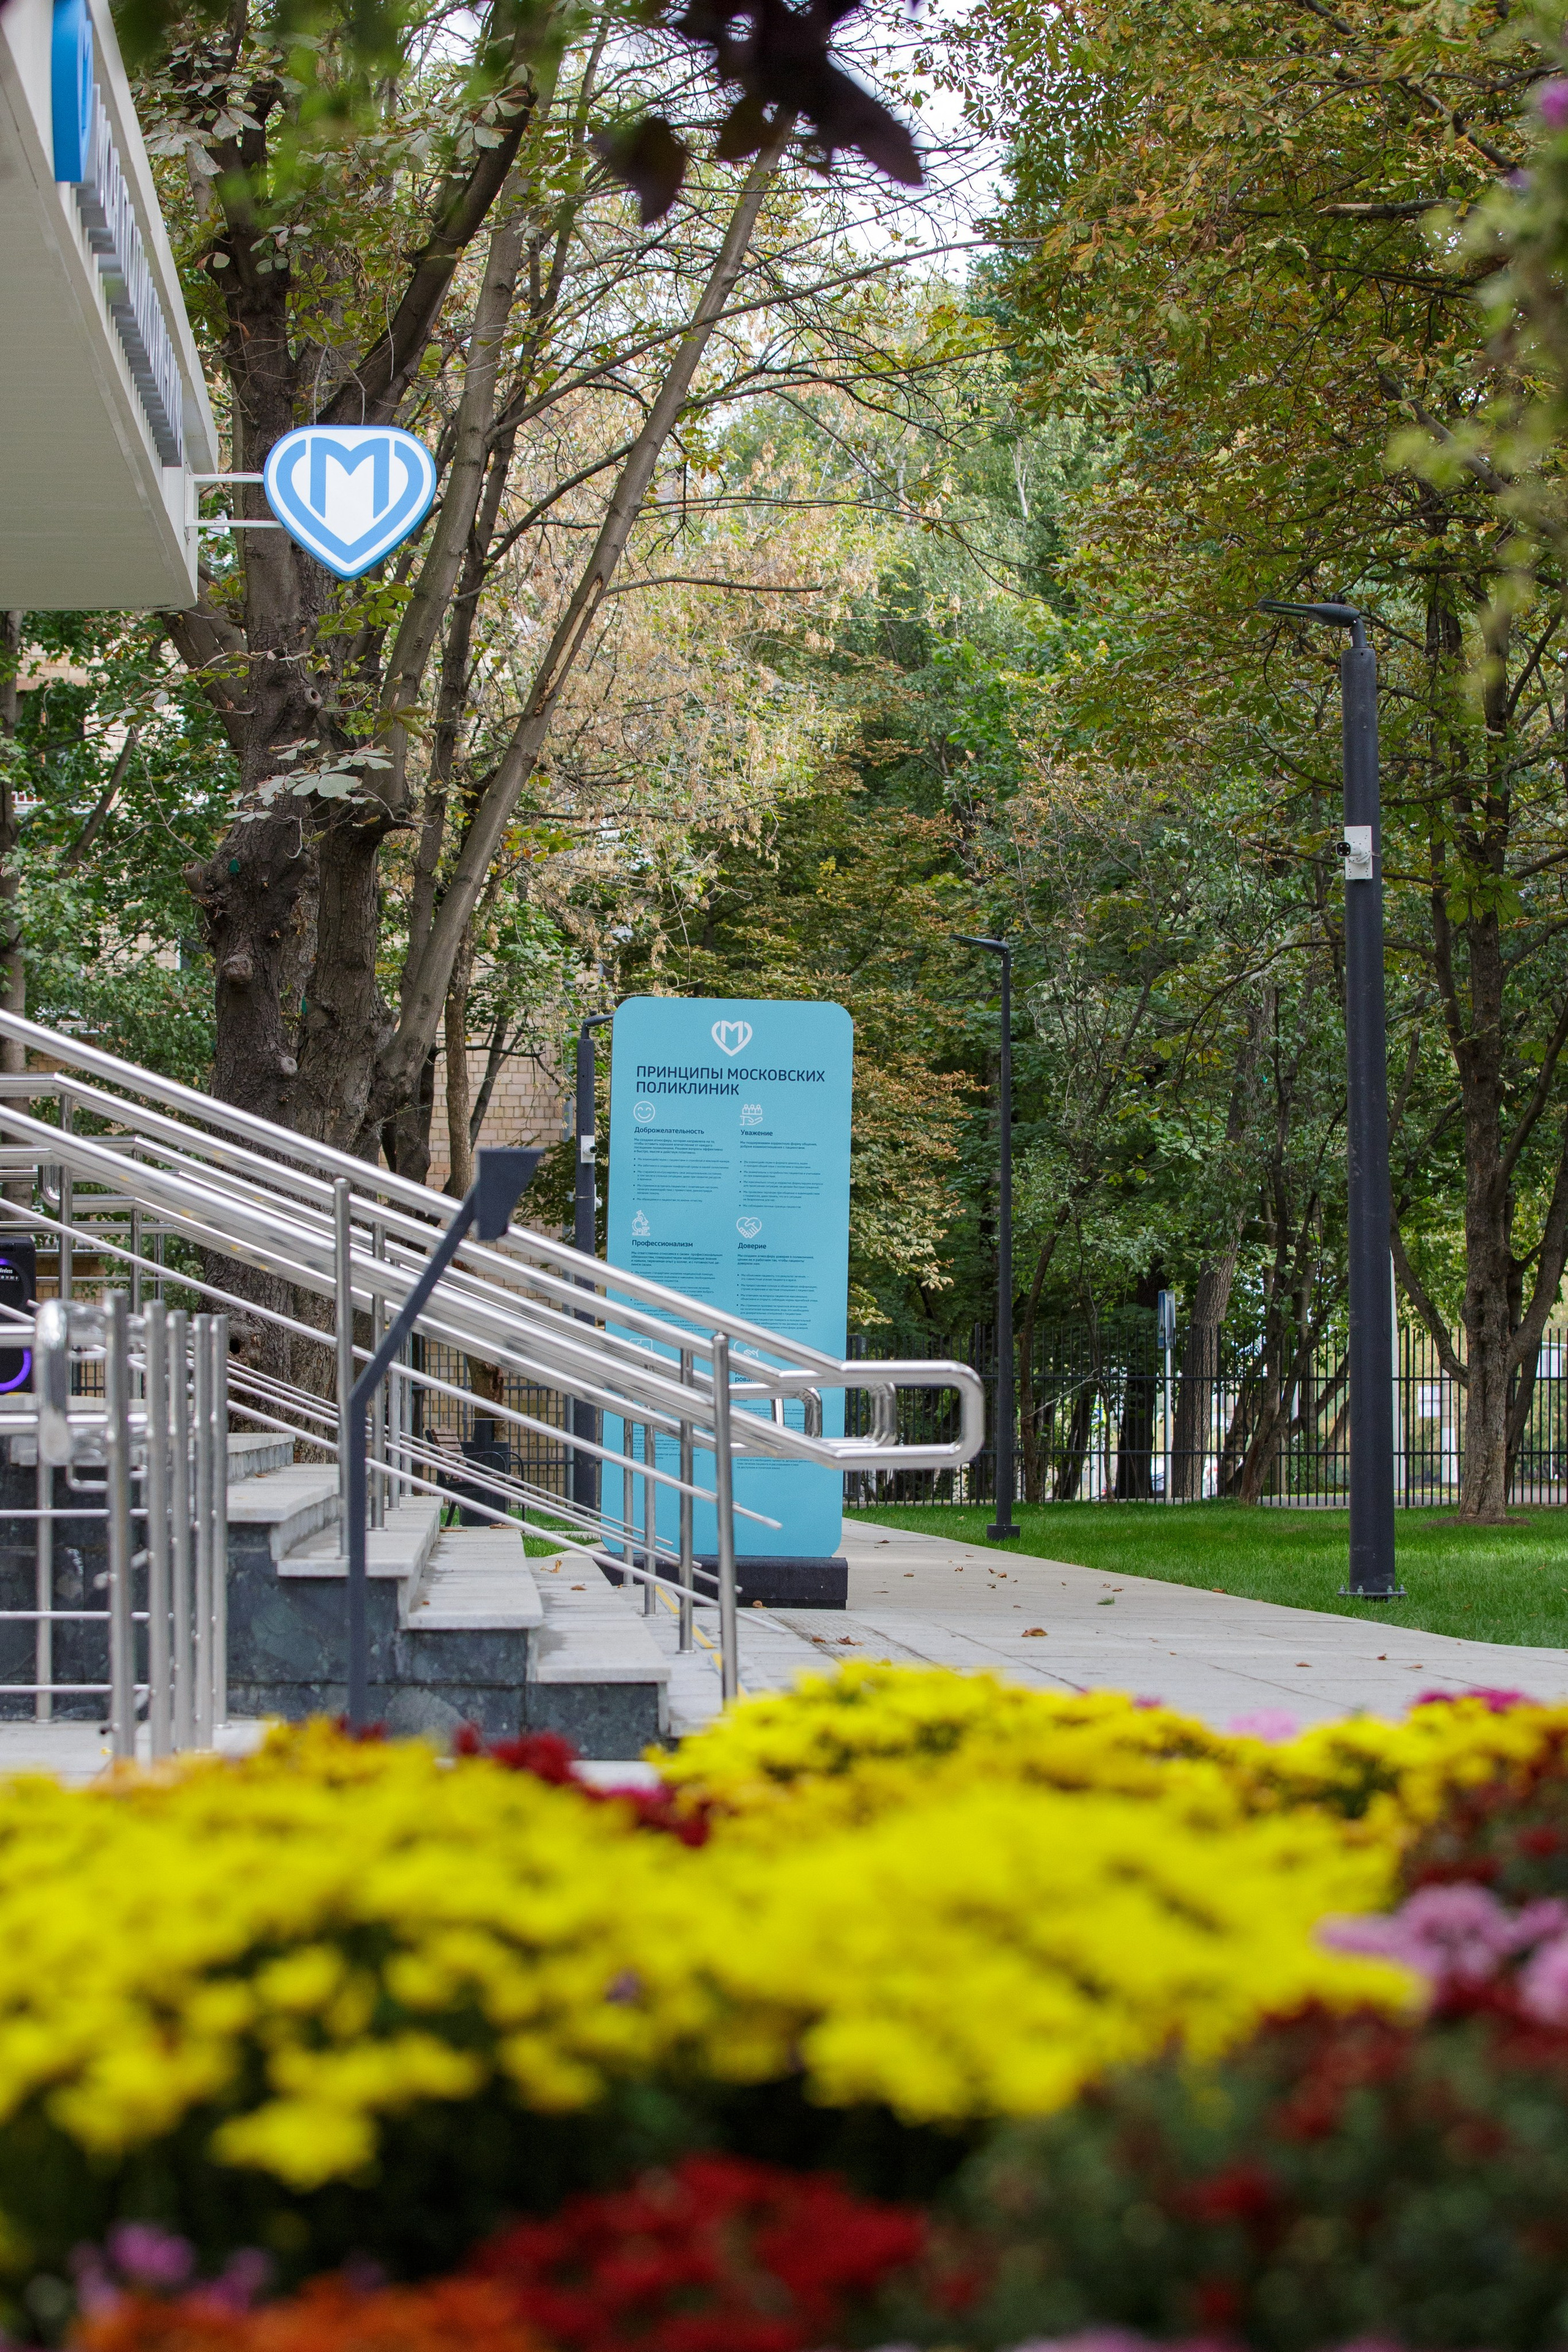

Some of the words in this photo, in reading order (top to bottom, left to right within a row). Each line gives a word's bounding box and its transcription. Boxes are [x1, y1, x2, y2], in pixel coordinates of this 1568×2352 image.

[636, 1065, 723, 1080] ПРИНЦИПЫ
[728, 1068, 825, 1082] МОСКОВСКИХ
[636, 1081, 739, 1096] ПОЛИКЛИНИК
[631, 1239, 693, 1248] Профессионализм
